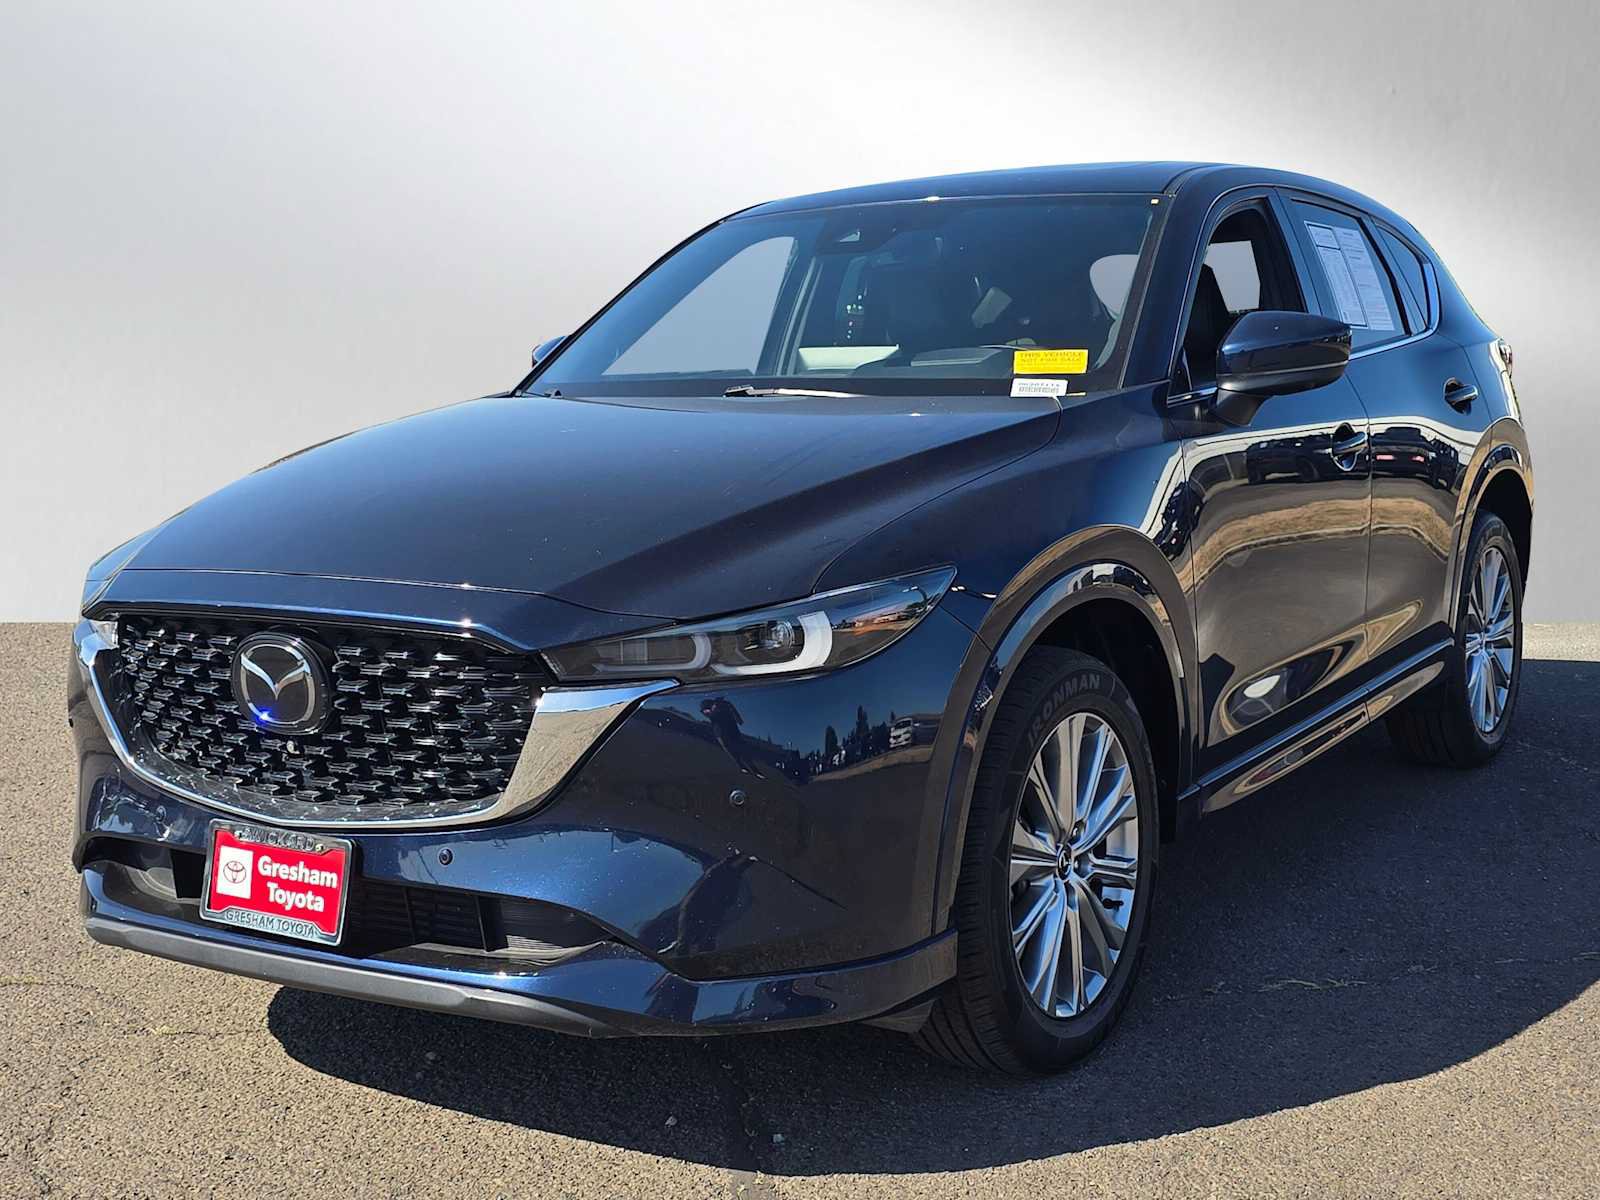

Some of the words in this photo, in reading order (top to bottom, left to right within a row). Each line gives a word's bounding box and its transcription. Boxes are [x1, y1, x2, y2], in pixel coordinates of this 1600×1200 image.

[1027, 673, 1101, 748] IRONMAN
[257, 855, 338, 888] Gresham
[267, 881, 325, 912] Toyota
[225, 910, 274, 930] GRESHAM
[276, 919, 315, 937] TOYOTA
